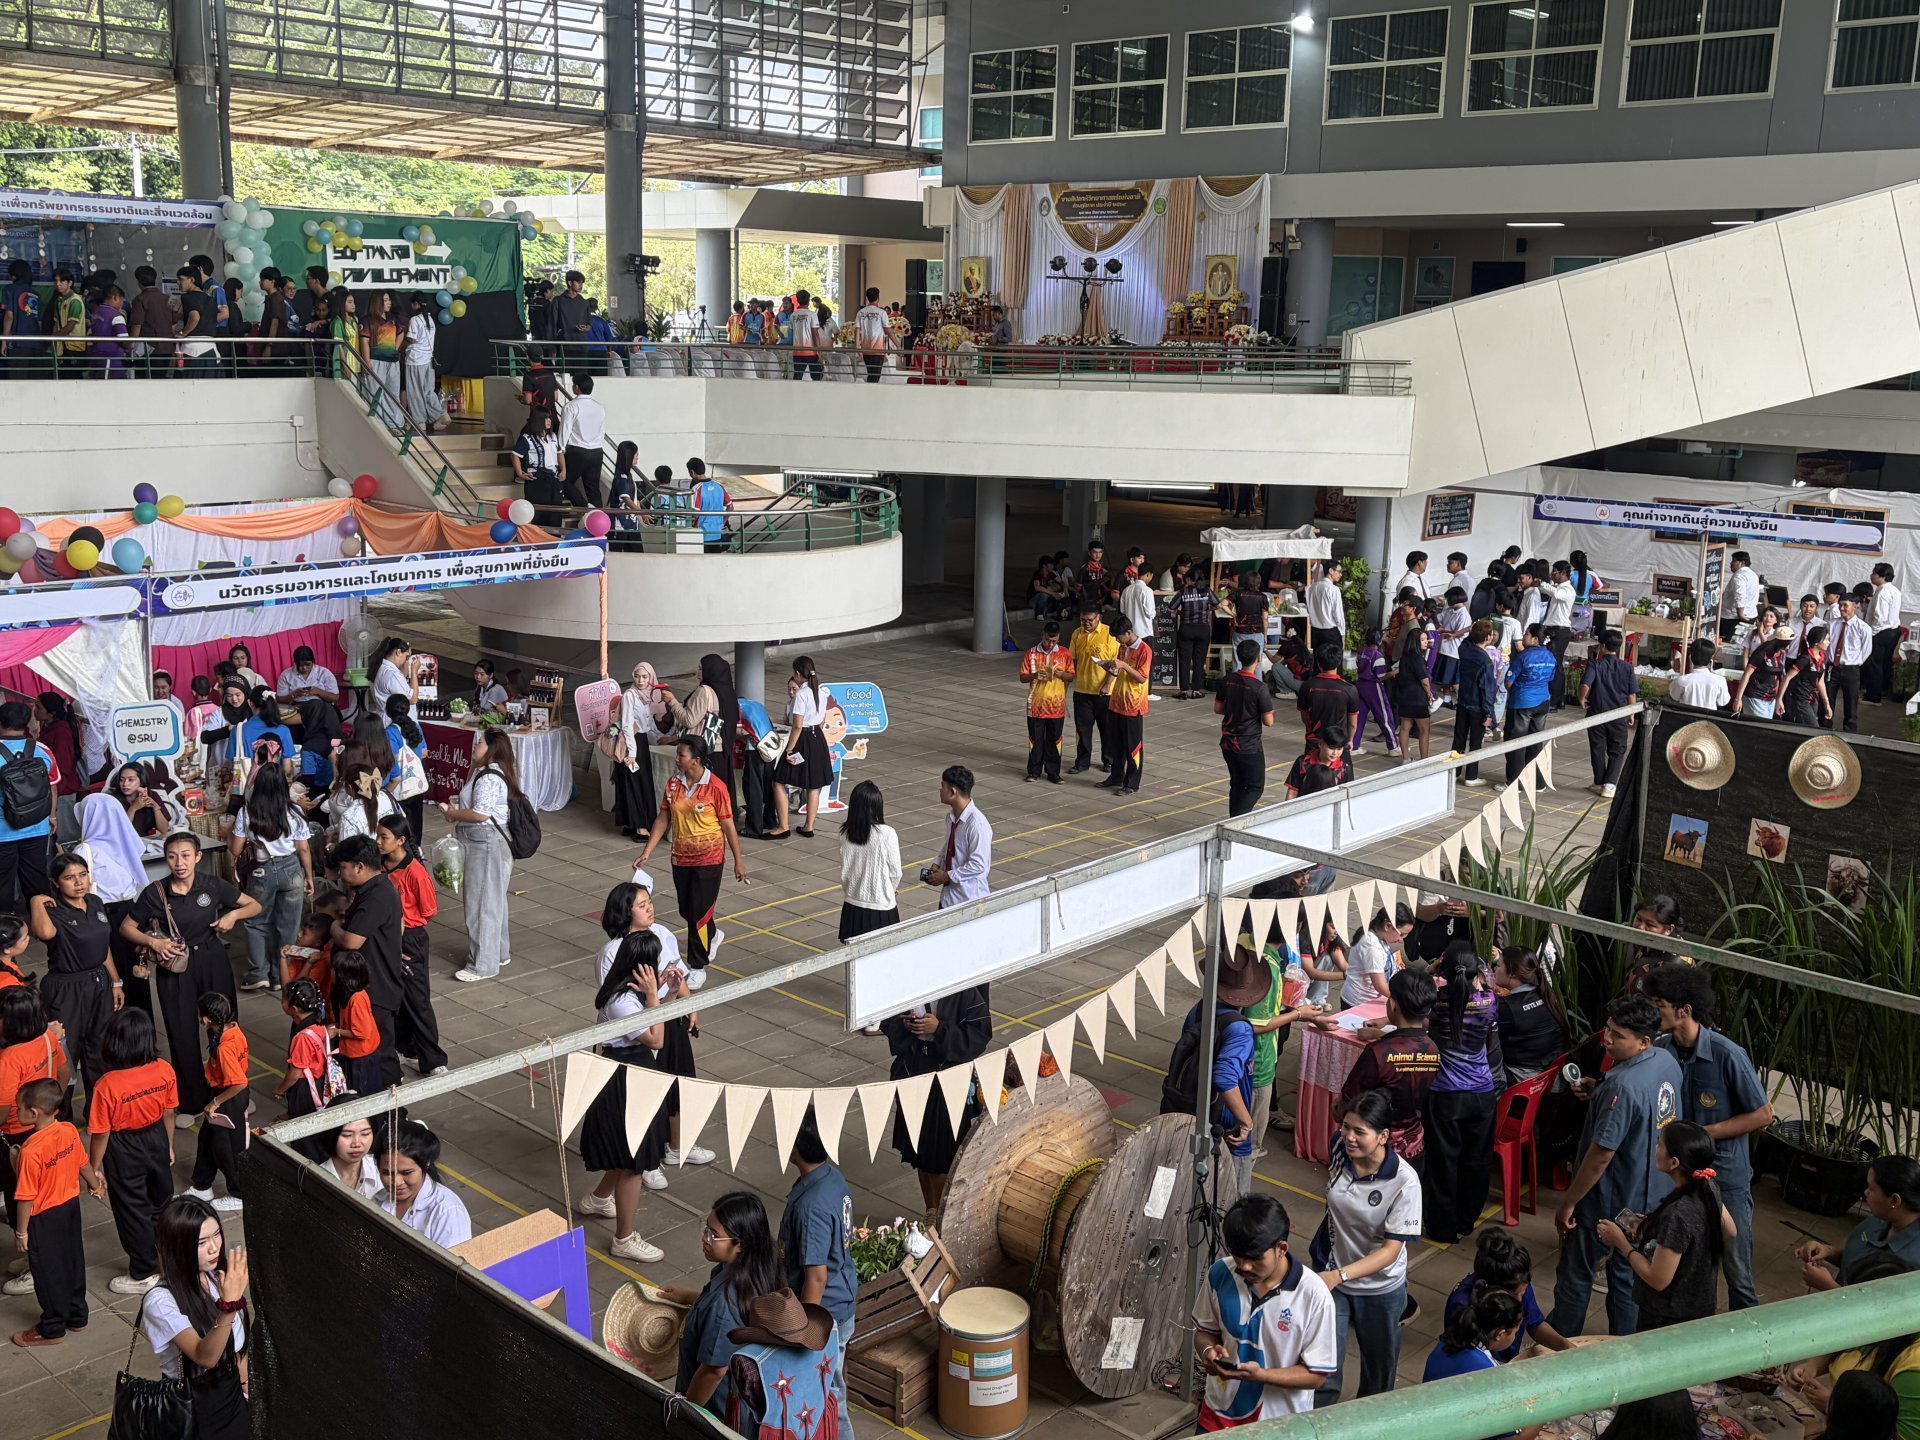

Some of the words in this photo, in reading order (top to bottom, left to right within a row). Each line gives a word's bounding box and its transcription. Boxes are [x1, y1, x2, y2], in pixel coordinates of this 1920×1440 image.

[1623, 509, 1778, 532] คุณค่าจากดินสู่ความยั่งยืน
[218, 567, 442, 600] นวัตกรรมอาหารและโภชนาการ
[447, 553, 569, 578] เพื่อสุขภาพที่ยั่งยืน
[115, 717, 168, 728] CHEMISTRY
[127, 733, 158, 744] @SRU
[427, 744, 452, 764] oselle
